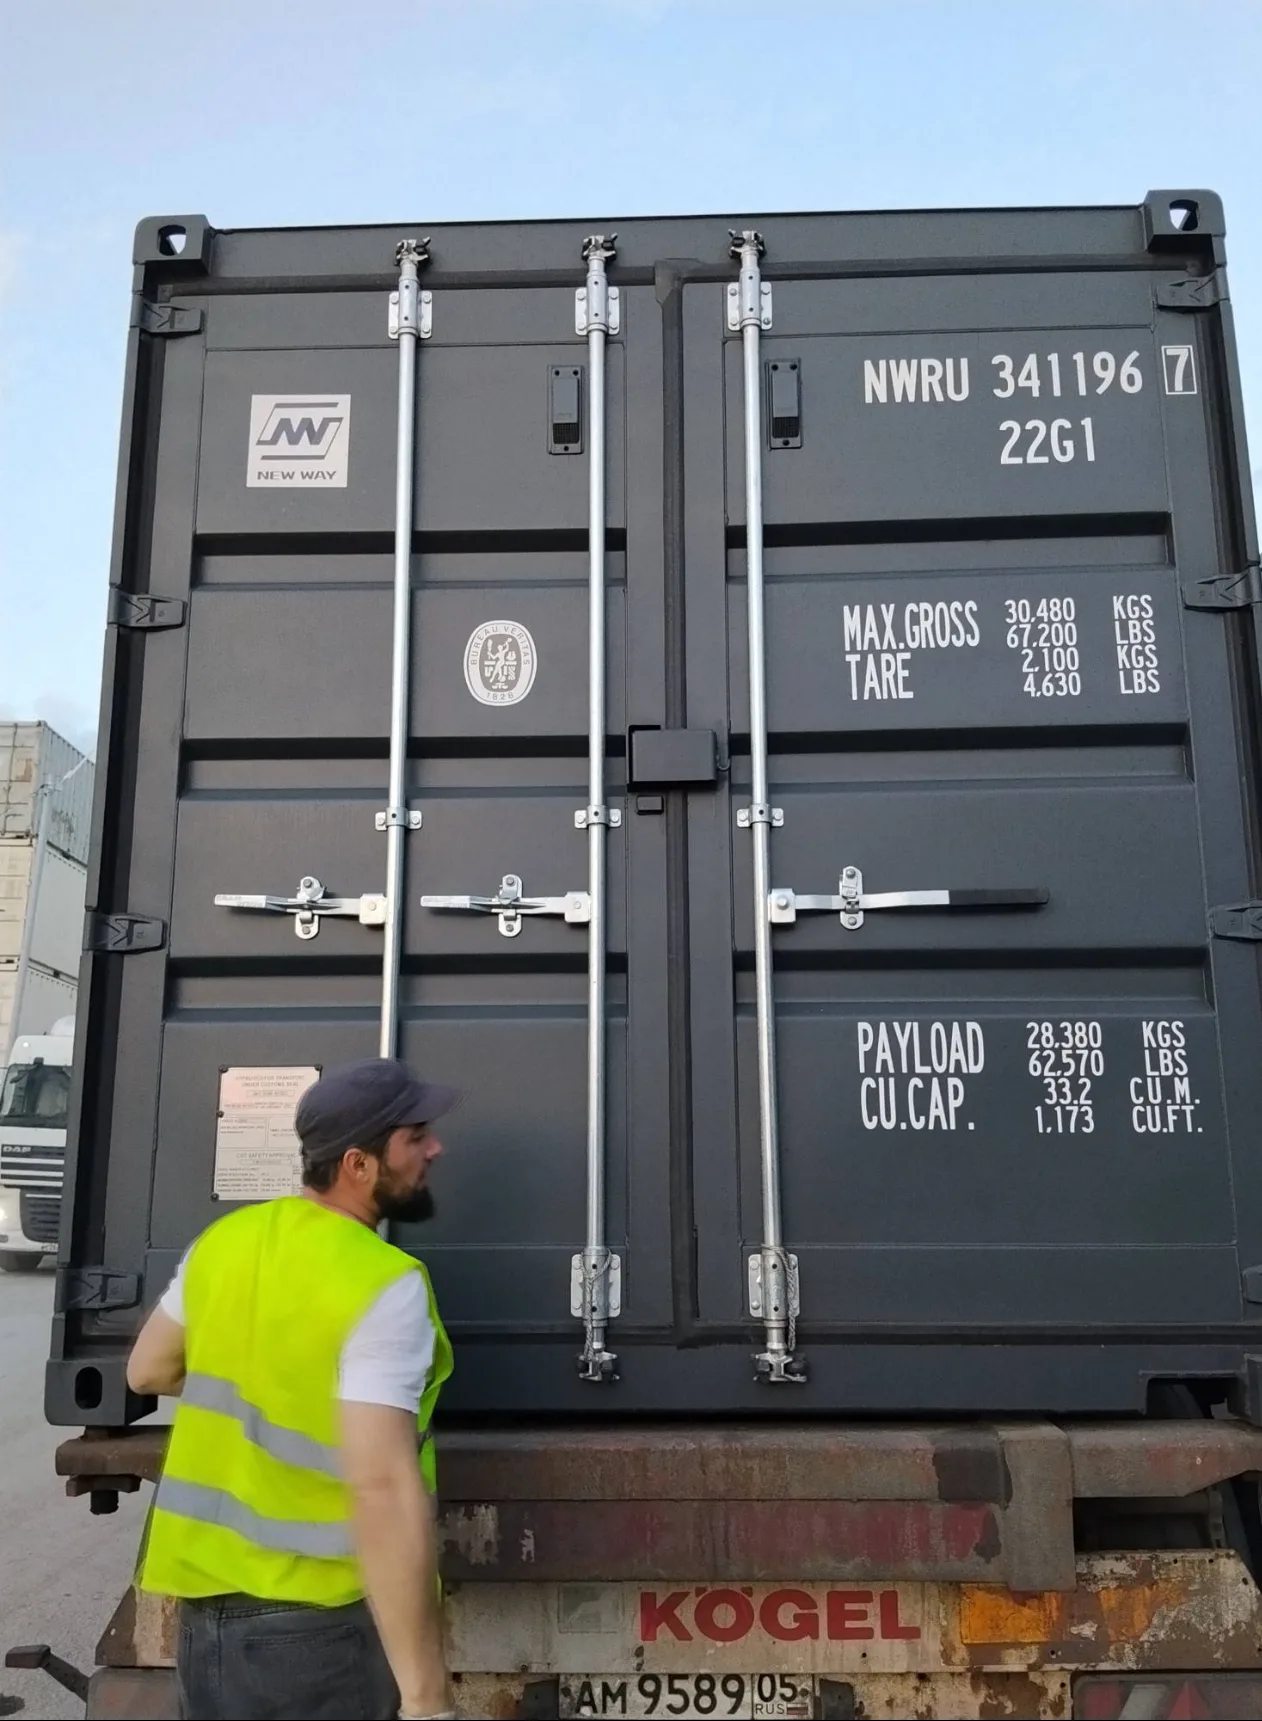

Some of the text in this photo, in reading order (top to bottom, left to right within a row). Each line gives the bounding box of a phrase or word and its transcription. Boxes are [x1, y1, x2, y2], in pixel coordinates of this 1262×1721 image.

[863, 347, 1190, 404] NWRU 341196 7
[999, 416, 1096, 465] 22G1
[257, 470, 337, 480] NEW WAY
[843, 600, 981, 651] MAX.GROSS
[1112, 594, 1154, 620] KGS
[1114, 619, 1156, 644] LBS
[470, 626, 531, 665] BUREAU VERITAS
[845, 652, 914, 701] TARE
[1116, 644, 1158, 670] KGS
[1118, 669, 1161, 695] LBS
[857, 1021, 985, 1074] PAYLOAD
[1141, 1020, 1186, 1048] KGS
[1144, 1048, 1188, 1076] LBS
[1043, 1077, 1093, 1105] 33.2
[640, 1586, 922, 1642] KÖGEL
[637, 1673, 746, 1715] 9589
[757, 1673, 799, 1703] 05
[755, 1703, 785, 1715] RUS
